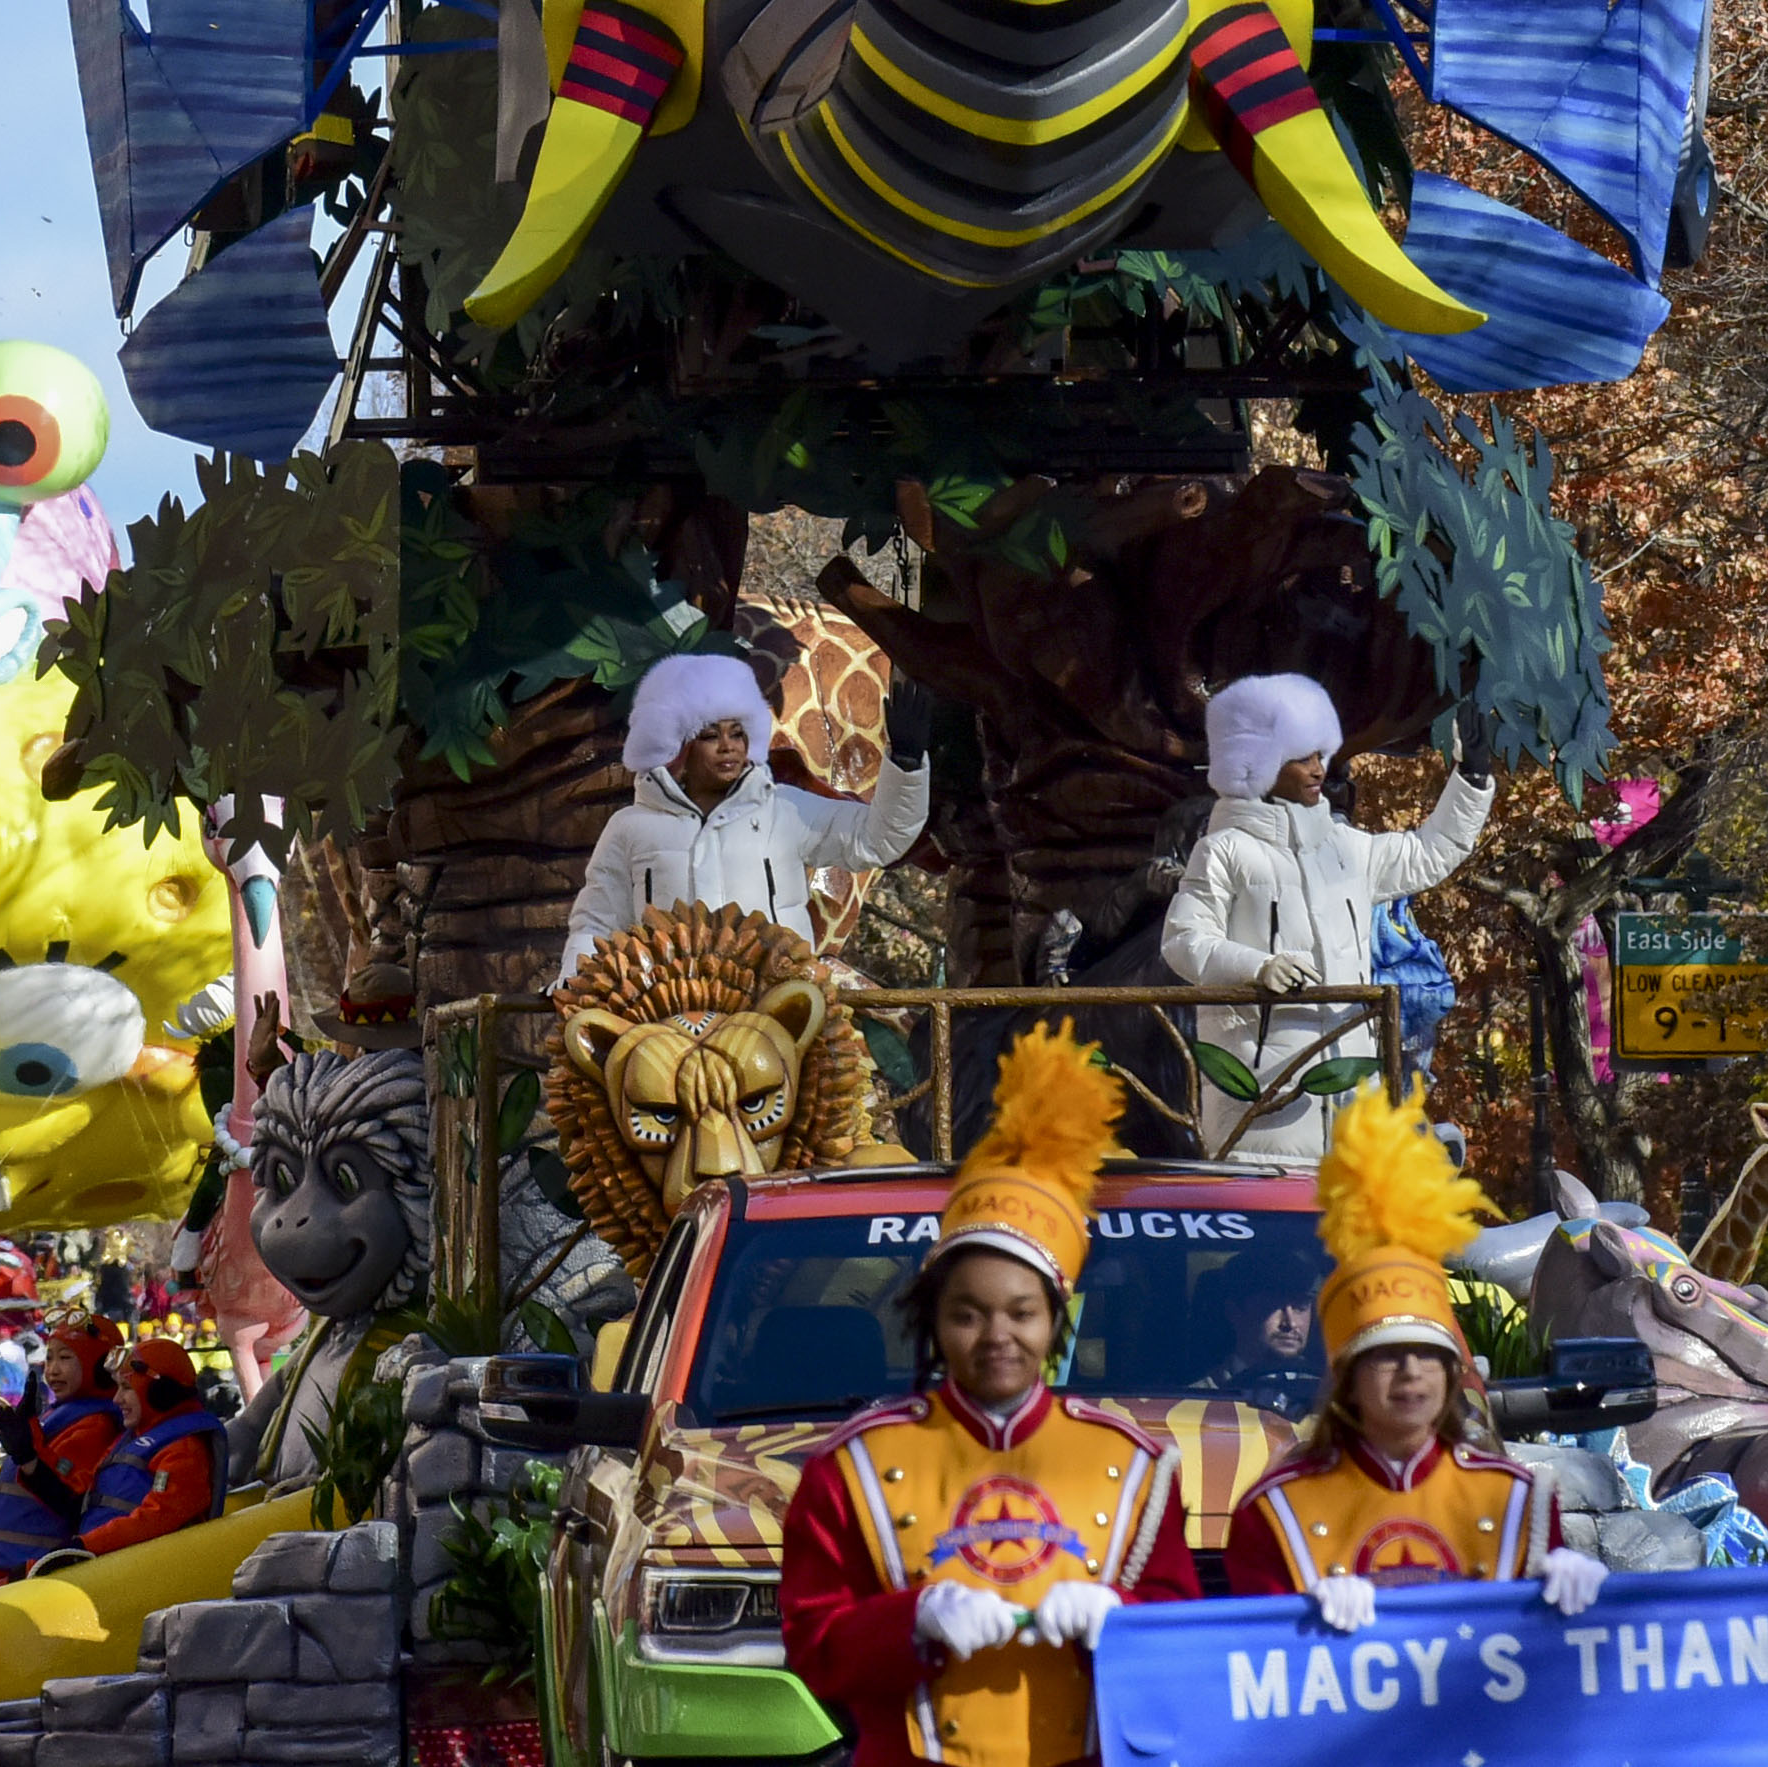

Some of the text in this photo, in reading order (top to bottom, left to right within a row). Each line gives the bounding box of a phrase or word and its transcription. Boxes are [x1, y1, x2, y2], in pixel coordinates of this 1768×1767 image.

[1626, 929, 1727, 951] East Side
[1626, 974, 1662, 993] LOW
[867, 1211, 1255, 1244] RA UCKS
[1227, 1624, 1527, 1721] MACY'S
